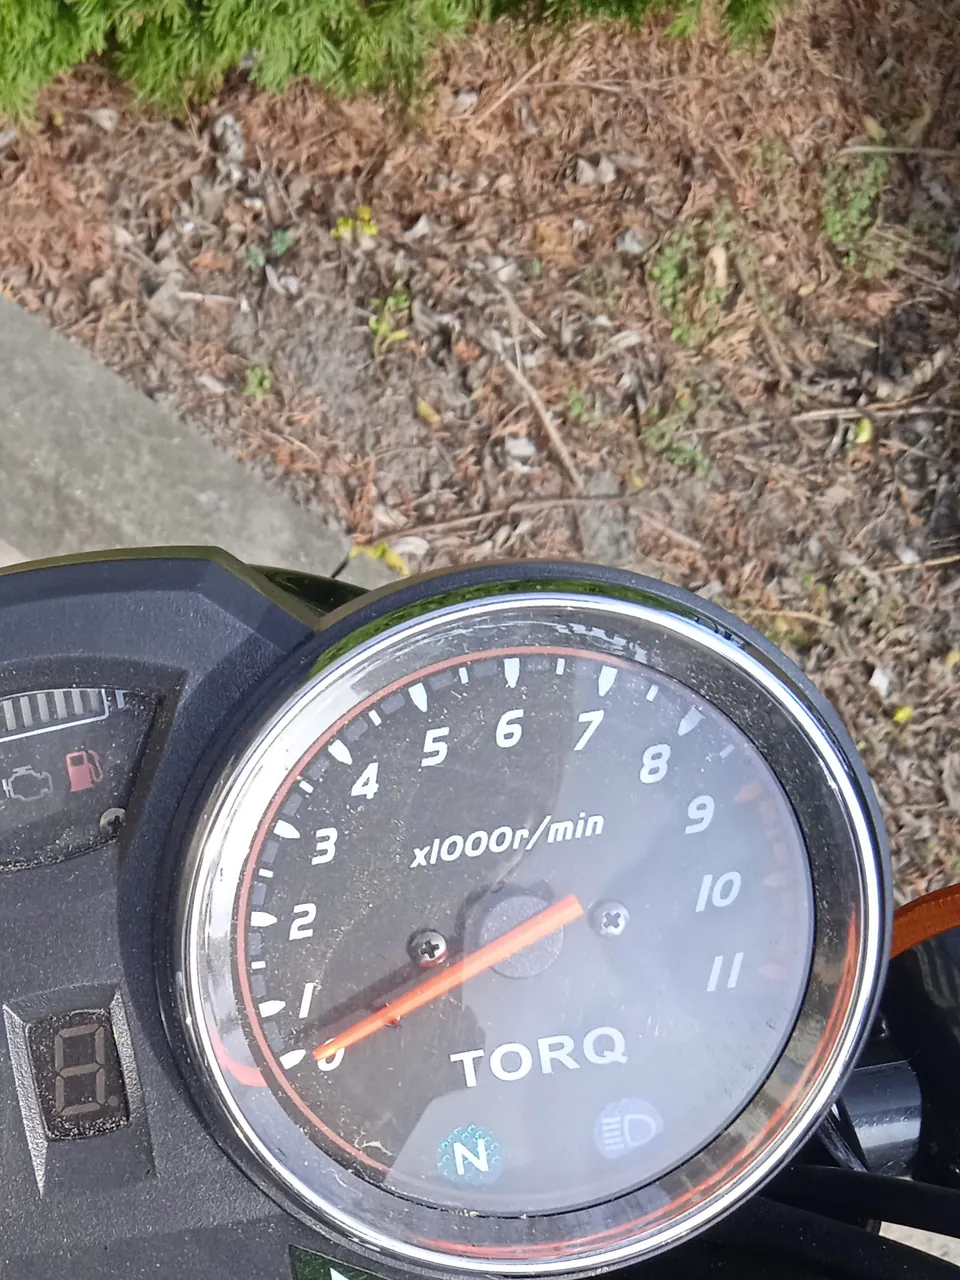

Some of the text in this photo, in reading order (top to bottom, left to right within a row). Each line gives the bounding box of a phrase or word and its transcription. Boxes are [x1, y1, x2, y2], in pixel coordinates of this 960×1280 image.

[420, 726, 450, 767] 5
[495, 708, 524, 748] 6
[573, 709, 605, 751] 7
[350, 762, 380, 800] 4
[639, 743, 671, 784] 8
[684, 794, 715, 835] 9
[311, 827, 338, 866] 3
[695, 871, 742, 913] 10
[288, 902, 317, 941] 2
[706, 951, 744, 992] 11
[298, 982, 315, 1019] 1
[449, 1026, 629, 1088] TORQ
[453, 1138, 489, 1176] N
